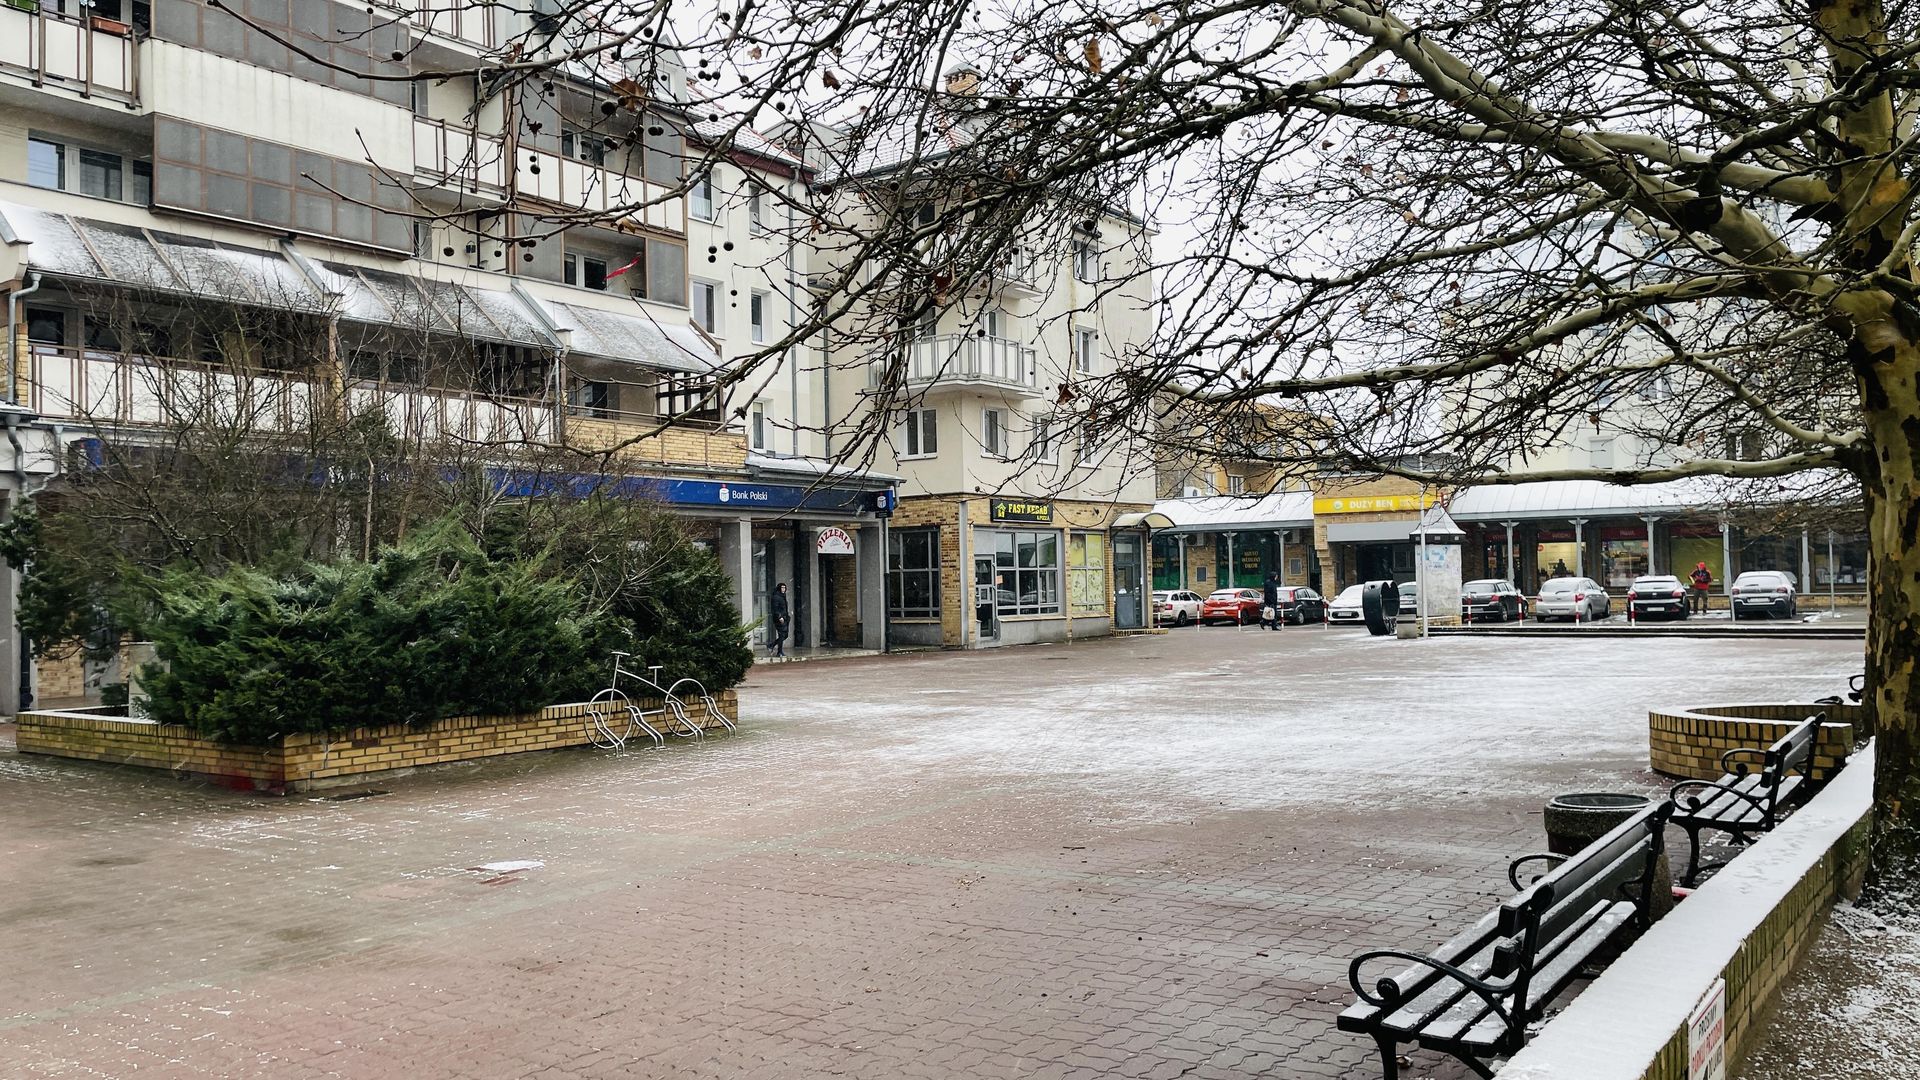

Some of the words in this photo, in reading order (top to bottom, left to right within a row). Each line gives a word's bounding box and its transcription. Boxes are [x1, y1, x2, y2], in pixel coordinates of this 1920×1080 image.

[732, 490, 749, 499] Bank
[750, 491, 768, 501] Polski
[1008, 503, 1025, 513] FAST
[1026, 504, 1048, 515] KEBAB
[1375, 499, 1393, 508] BEN
[818, 528, 851, 549] PIZZERIA
